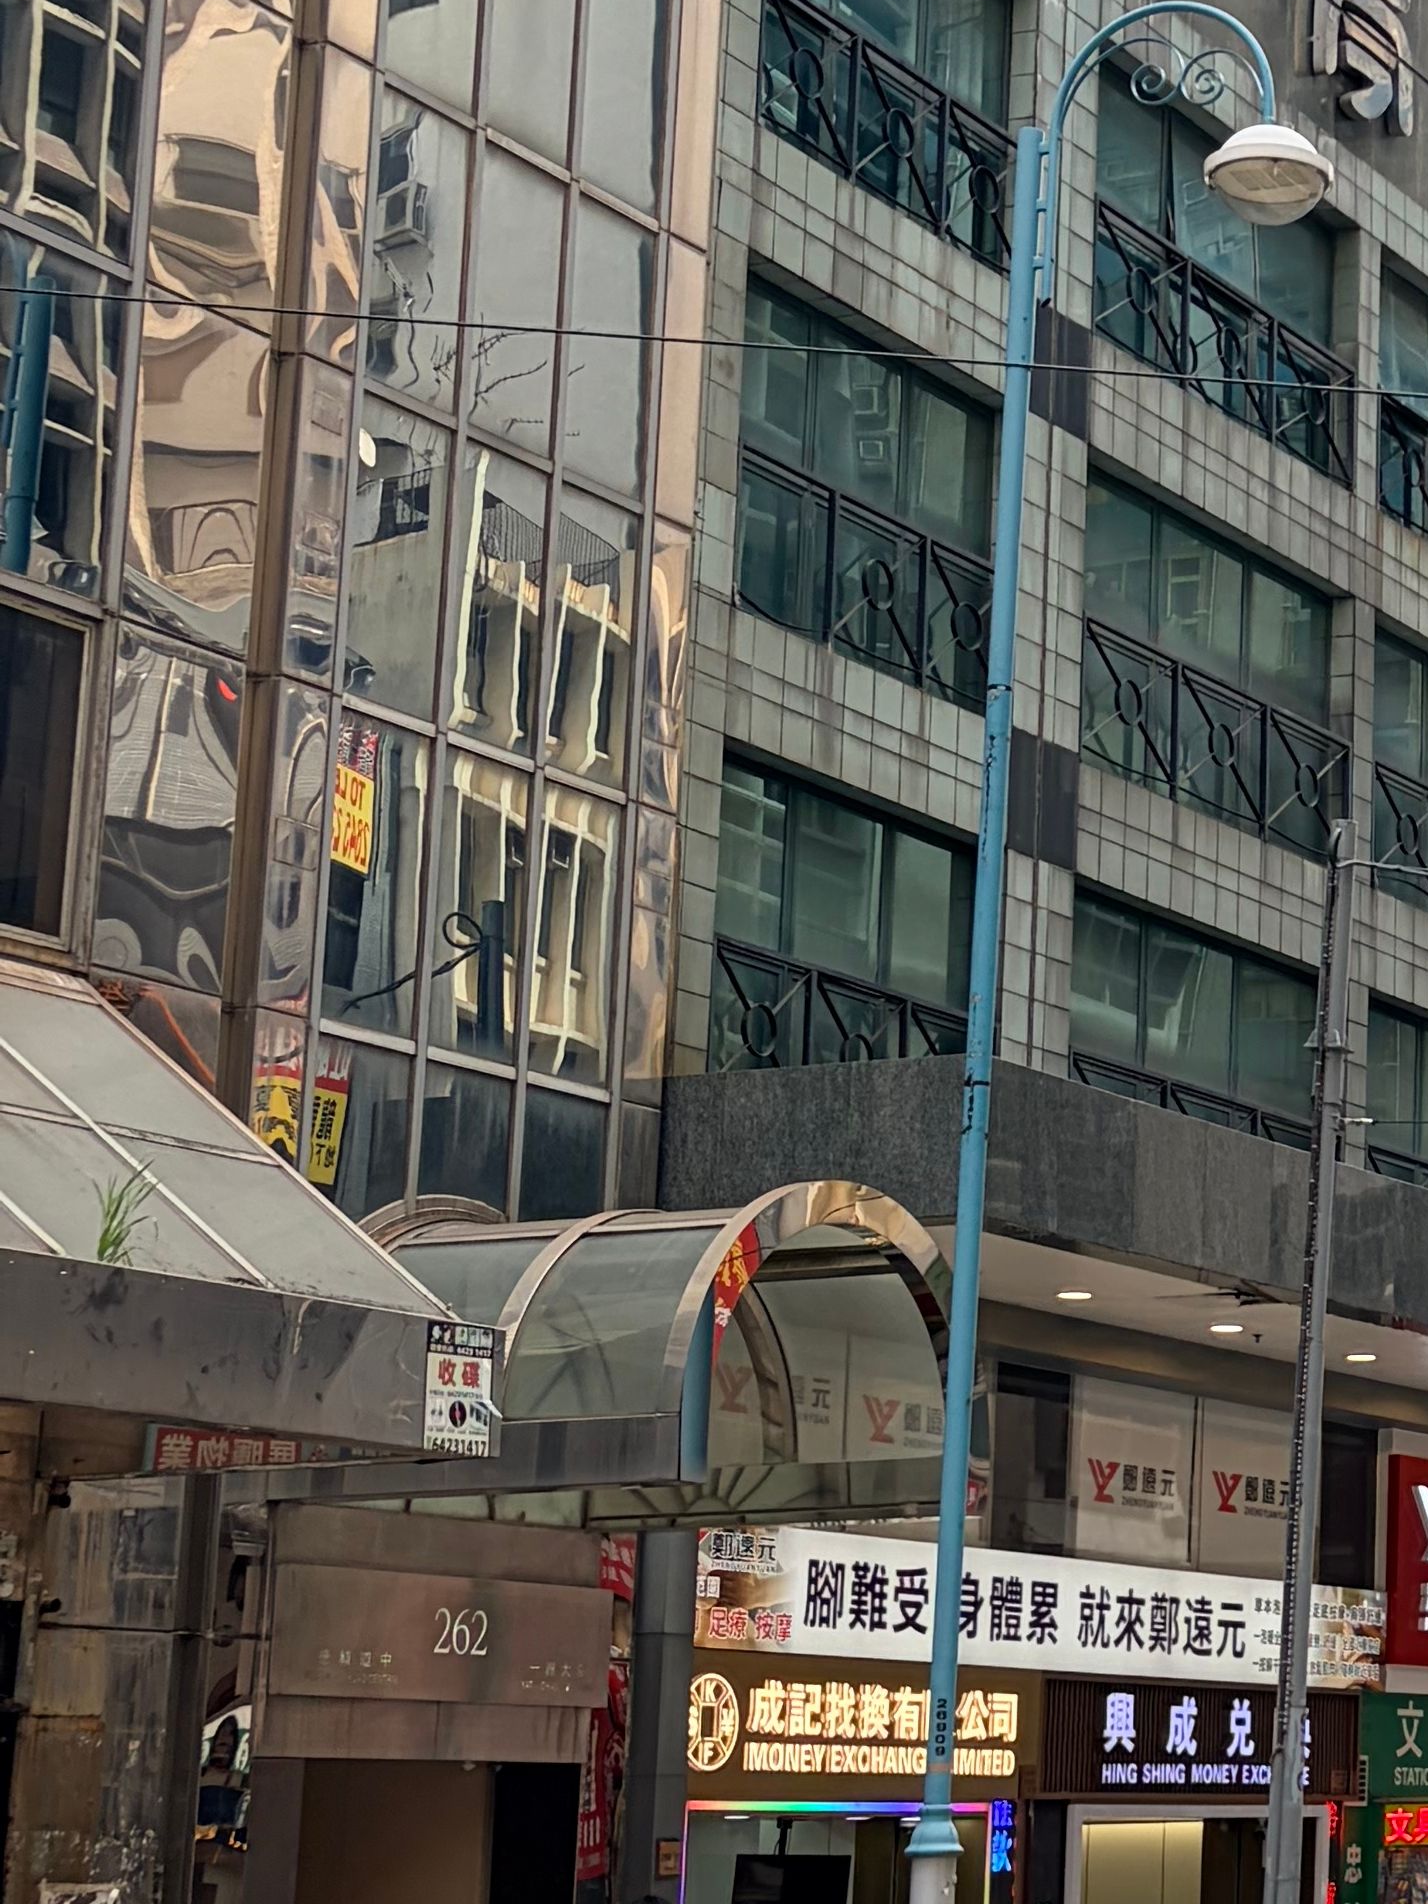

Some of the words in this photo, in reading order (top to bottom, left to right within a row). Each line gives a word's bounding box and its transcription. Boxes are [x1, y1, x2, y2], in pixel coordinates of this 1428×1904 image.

[433, 1607, 488, 1656] 262
[803, 1558, 930, 1635] 腳難受
[1077, 1584, 1247, 1659] 就來鄭遠元
[747, 1679, 1018, 1746] 成記找換有公司
[829, 1747, 927, 1774] EXCHANG
[953, 1748, 1016, 1776] IMITED
[1101, 1764, 1138, 1786] HING
[1142, 1764, 1186, 1786] SHING
[1191, 1766, 1238, 1786] MONEY
